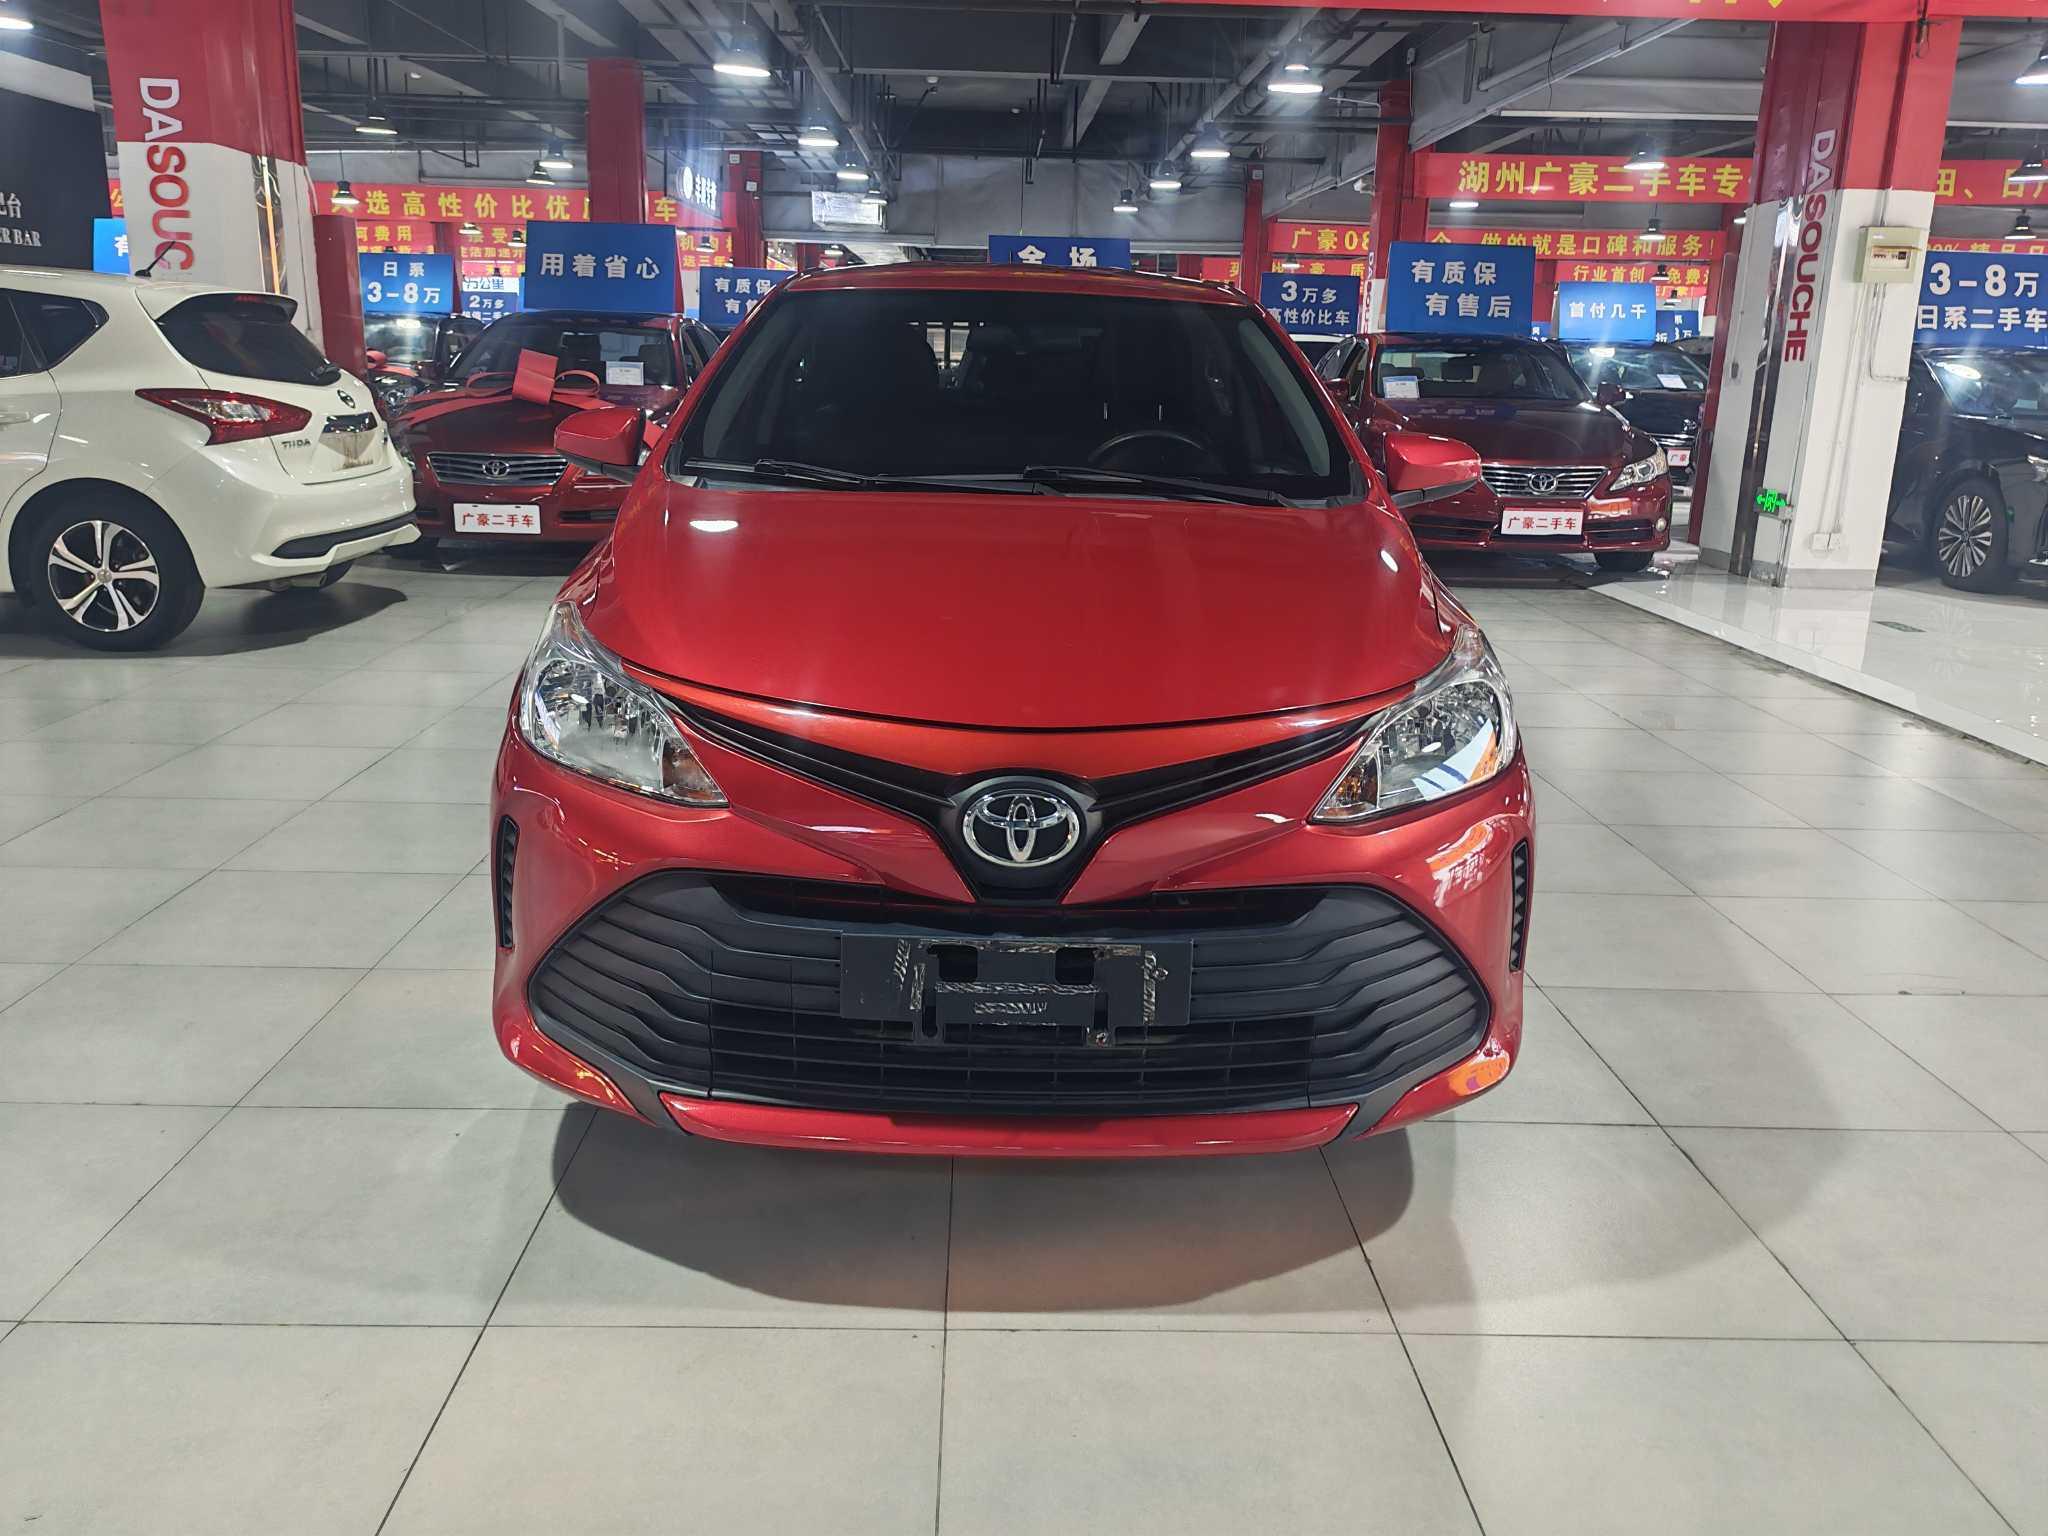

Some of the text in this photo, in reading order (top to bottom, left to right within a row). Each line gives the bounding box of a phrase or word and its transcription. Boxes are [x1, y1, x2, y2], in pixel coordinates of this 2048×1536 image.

[331, 189, 590, 220] 选高性价比优
[13, 228, 42, 247] BAR
[1784, 129, 1838, 362] DASOUCHE
[383, 261, 425, 277] 日系
[540, 253, 661, 280] 用着省心
[1411, 259, 1497, 286] 有质保
[714, 278, 771, 294] 有质保
[1929, 262, 2039, 298] 3-8万
[367, 281, 441, 304] 3-8万
[1280, 280, 1337, 304] 3万多
[1425, 292, 1512, 318] 有售后
[1569, 302, 1647, 320] 首付几千
[1268, 308, 1350, 326] 高性价比车
[1917, 305, 2048, 333] 日系二手车
[462, 511, 535, 528] 广豪二手车
[1507, 516, 1577, 530] 广豪二手车
